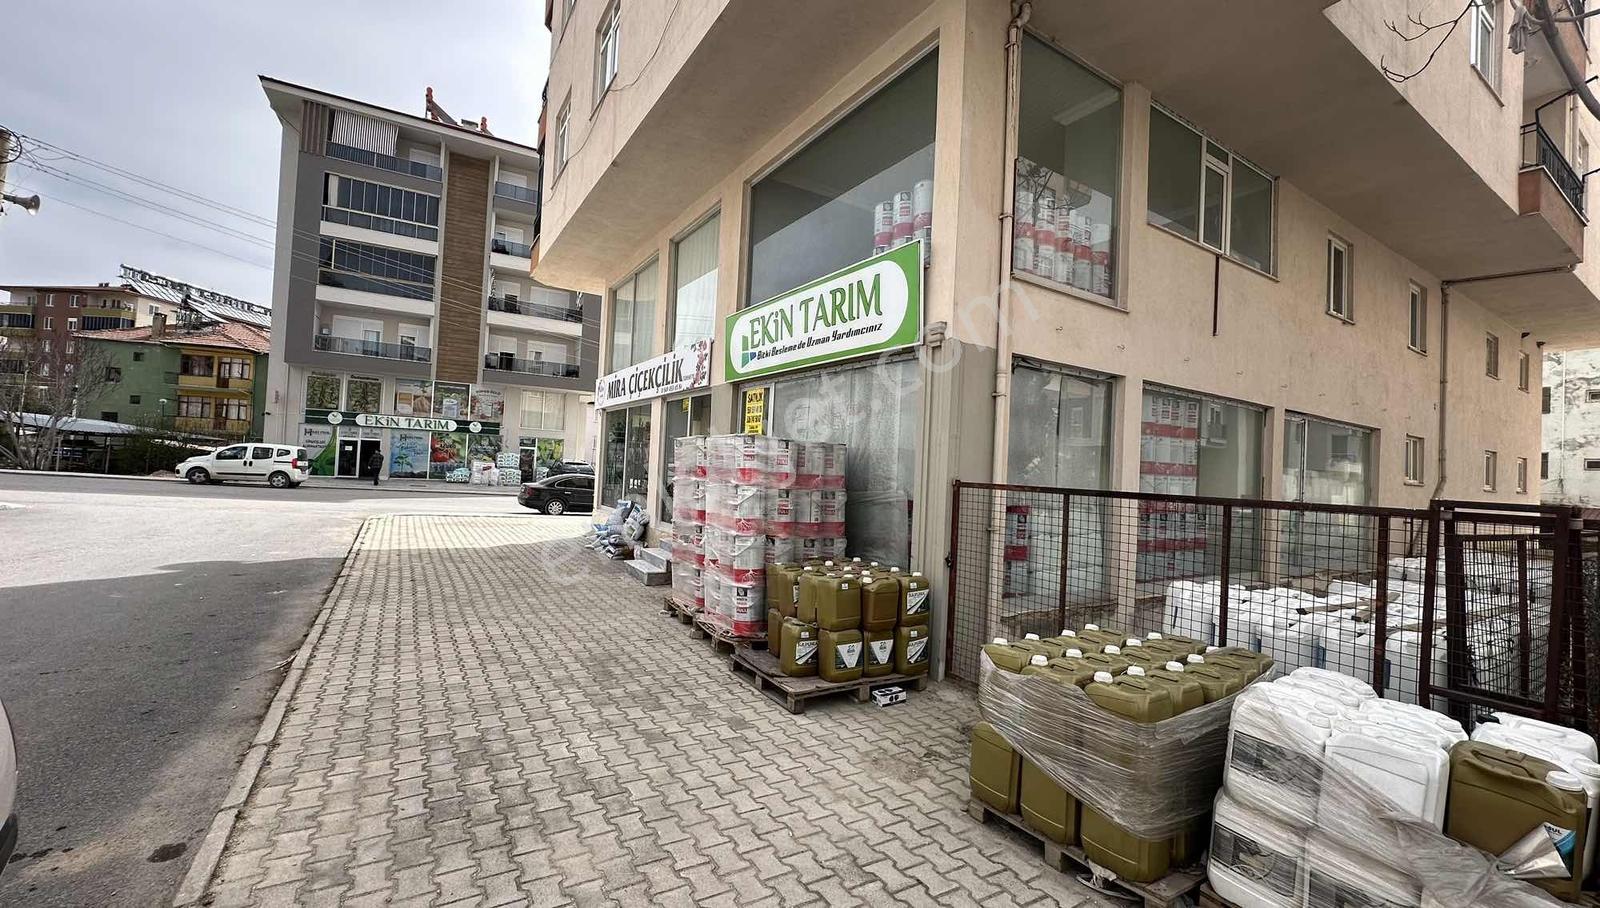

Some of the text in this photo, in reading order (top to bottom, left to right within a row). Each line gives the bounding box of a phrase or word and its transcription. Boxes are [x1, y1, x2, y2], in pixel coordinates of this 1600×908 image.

[799, 273, 883, 334] TARIM
[771, 343, 797, 357] Besleme
[797, 339, 806, 351] de
[807, 335, 830, 349] Uzman
[606, 353, 684, 400] MİRA ÇİÇEKÇİLİK
[405, 418, 450, 430] TARIM
